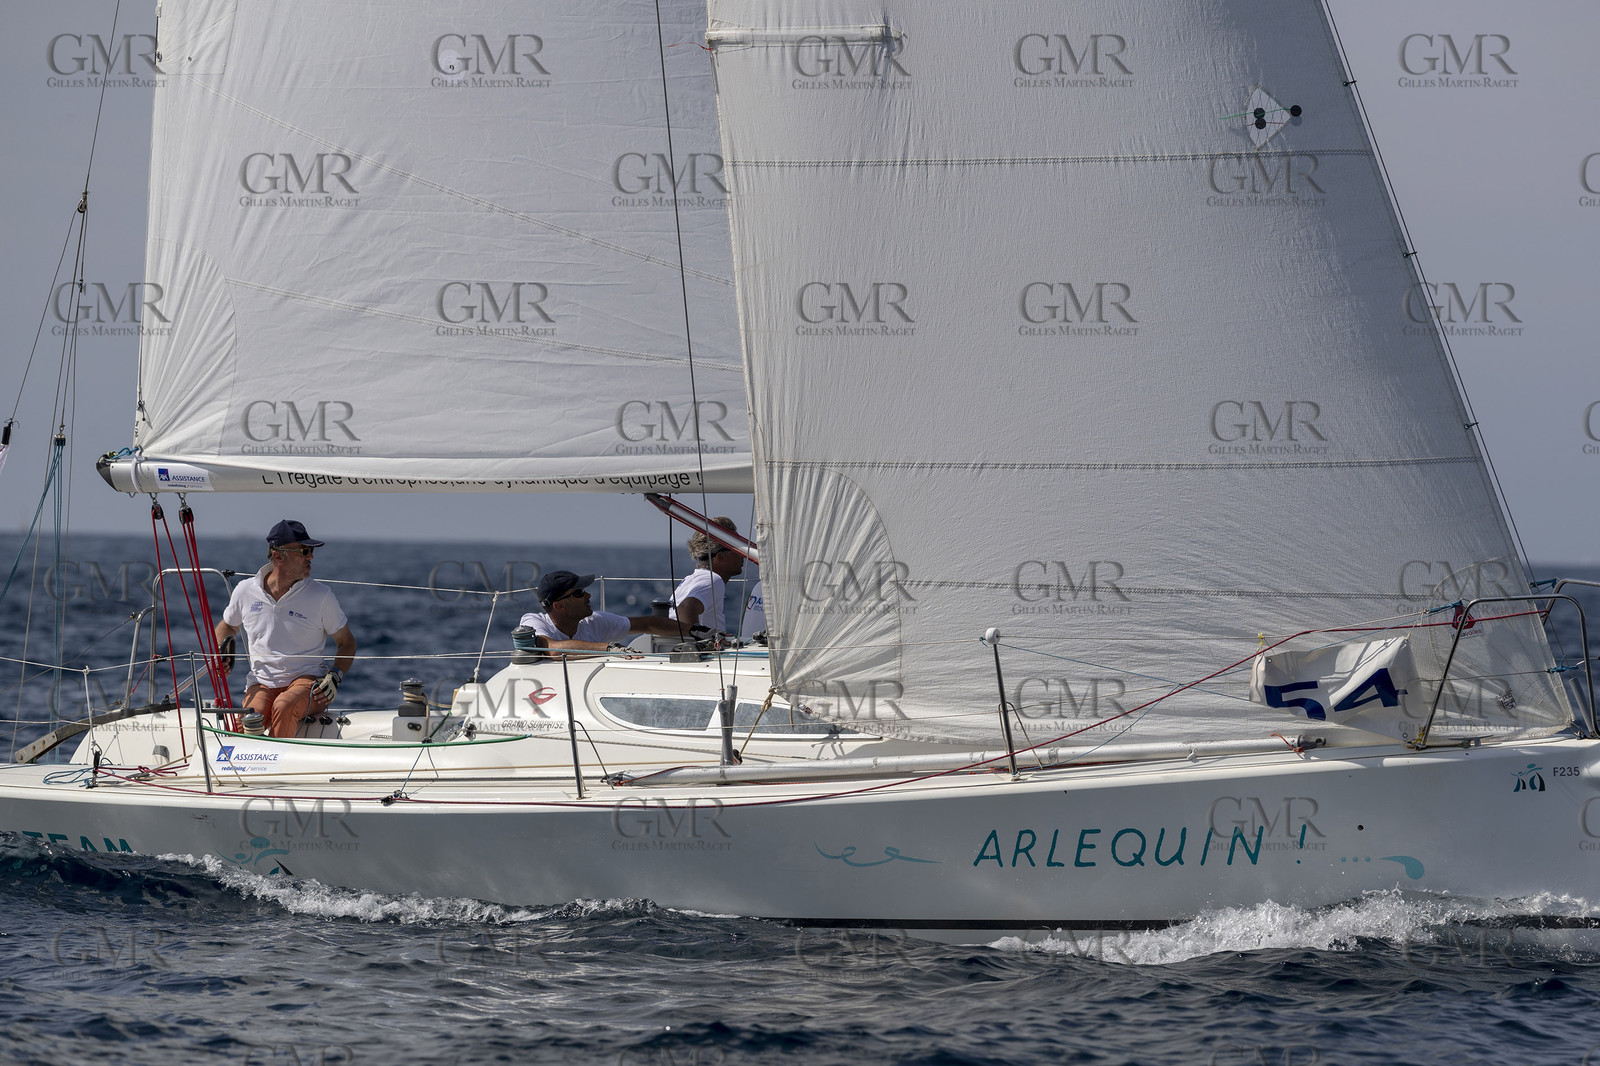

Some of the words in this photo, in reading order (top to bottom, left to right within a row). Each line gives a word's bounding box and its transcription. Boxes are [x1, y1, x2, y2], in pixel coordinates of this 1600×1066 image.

[1264, 668, 1408, 721] 54
[501, 719, 527, 729] GRAND
[528, 719, 566, 730] SURPRISE
[234, 753, 279, 761] ASSISTANCE
[1553, 766, 1580, 776] F235
[22, 830, 133, 852] AM
[974, 827, 1264, 867] ARLEQUIN
